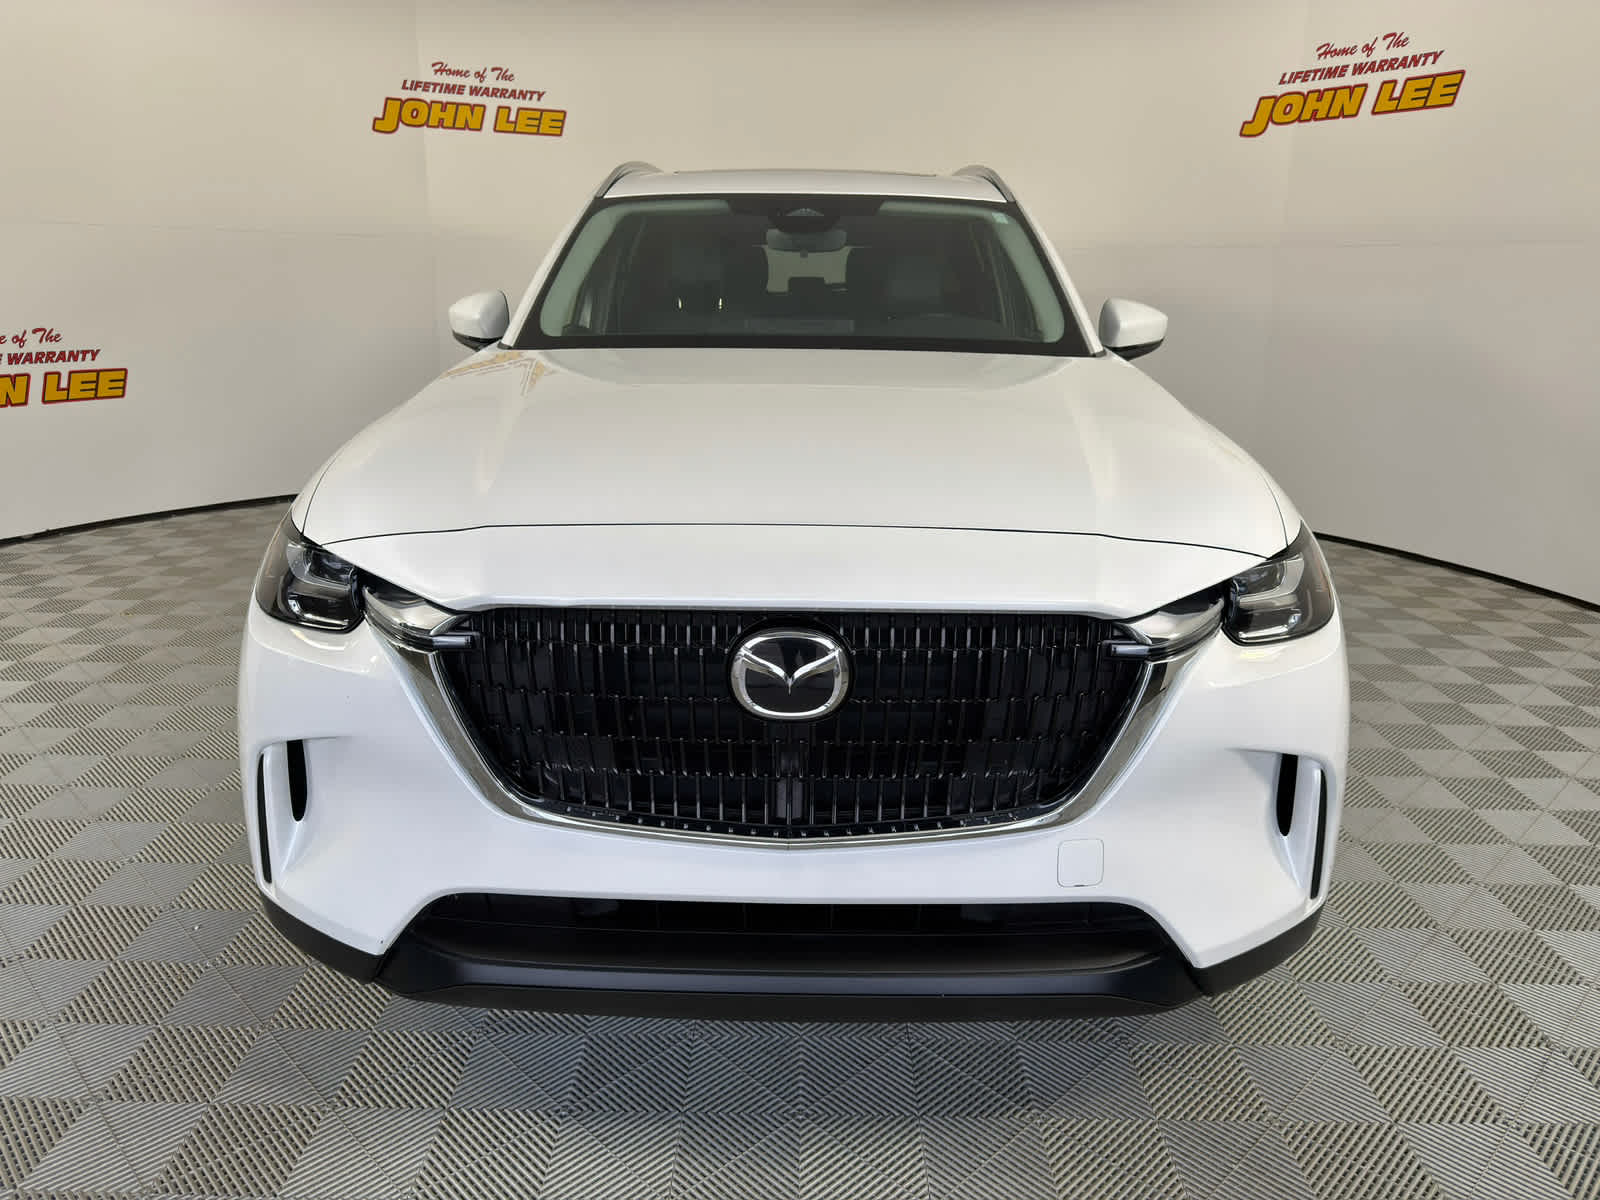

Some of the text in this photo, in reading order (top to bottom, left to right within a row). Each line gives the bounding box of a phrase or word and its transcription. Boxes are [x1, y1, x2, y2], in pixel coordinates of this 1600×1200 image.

[1316, 32, 1410, 60] Home of The
[431, 61, 515, 83] Home of The
[1278, 50, 1445, 85] LIFETIME WARRANTY
[401, 79, 546, 102] LIFETIME WARRANTY
[1239, 69, 1466, 138] JOHN LEE
[372, 97, 567, 137] JOHN LEE
[11, 329, 28, 349] of
[31, 327, 62, 344] The
[7, 348, 101, 366] WARRANTY
[41, 367, 128, 405] LEE
